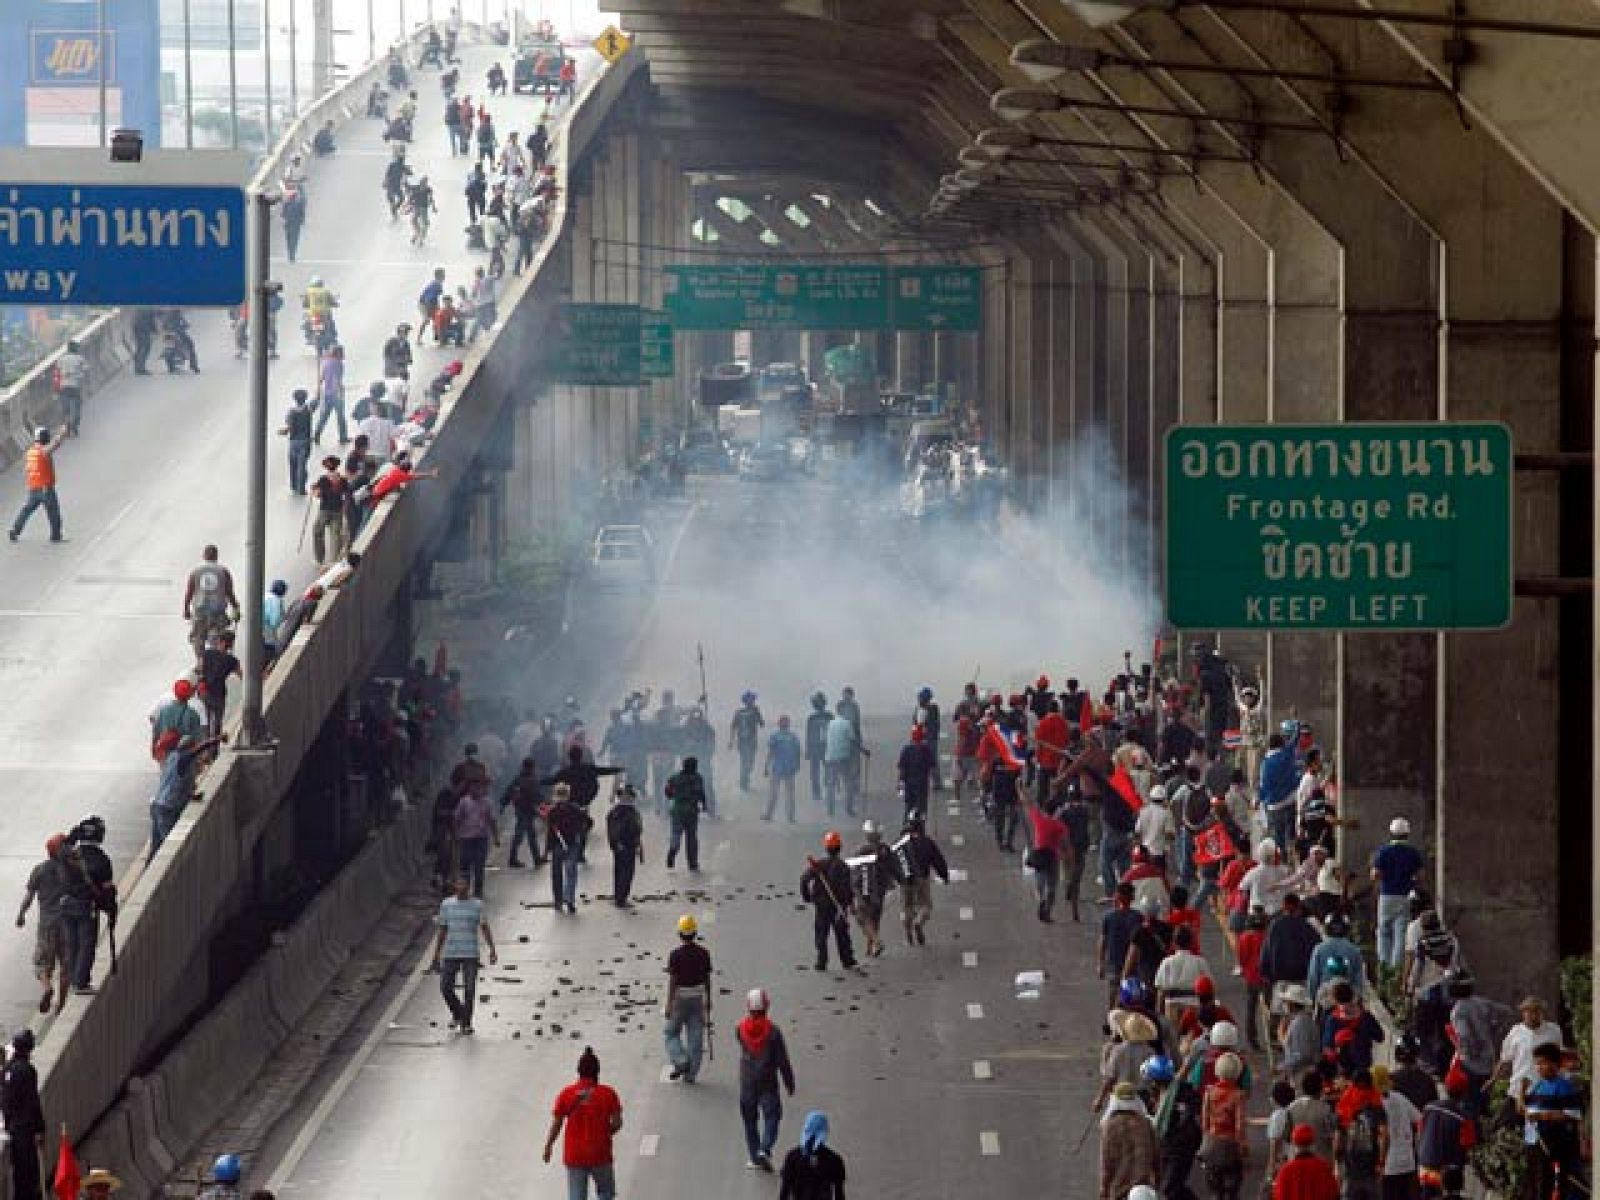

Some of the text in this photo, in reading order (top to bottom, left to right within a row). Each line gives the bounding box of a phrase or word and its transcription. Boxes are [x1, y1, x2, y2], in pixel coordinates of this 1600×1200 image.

[4, 269, 78, 301] way
[1181, 439, 1495, 478] ออกทางขนาน
[1227, 494, 1392, 526] Frontage
[1260, 523, 1412, 580] ชิดซ้าย
[1246, 596, 1429, 621] KEEP LEFT
